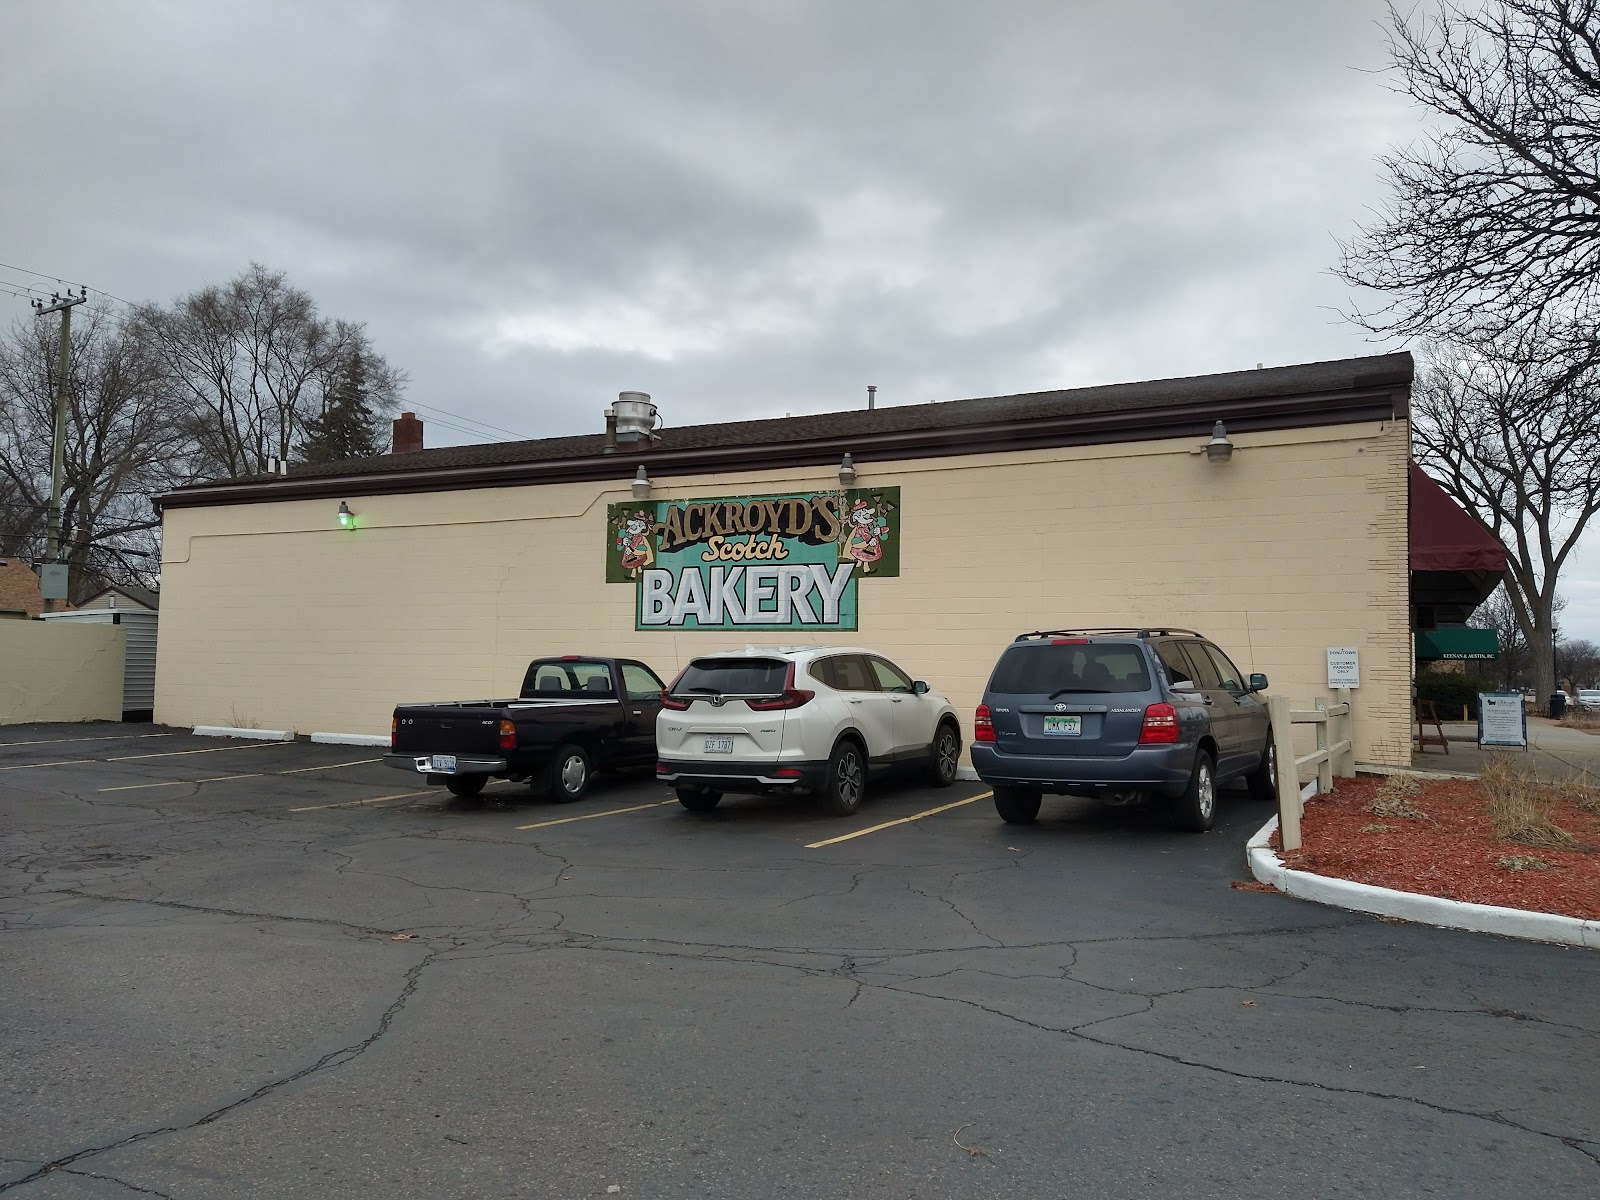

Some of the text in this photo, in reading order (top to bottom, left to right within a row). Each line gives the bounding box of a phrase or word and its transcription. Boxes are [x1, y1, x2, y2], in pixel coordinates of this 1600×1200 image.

[652, 496, 842, 551] ACKROYD'S
[702, 534, 789, 562] Scotch
[640, 563, 856, 626] BAKERY
